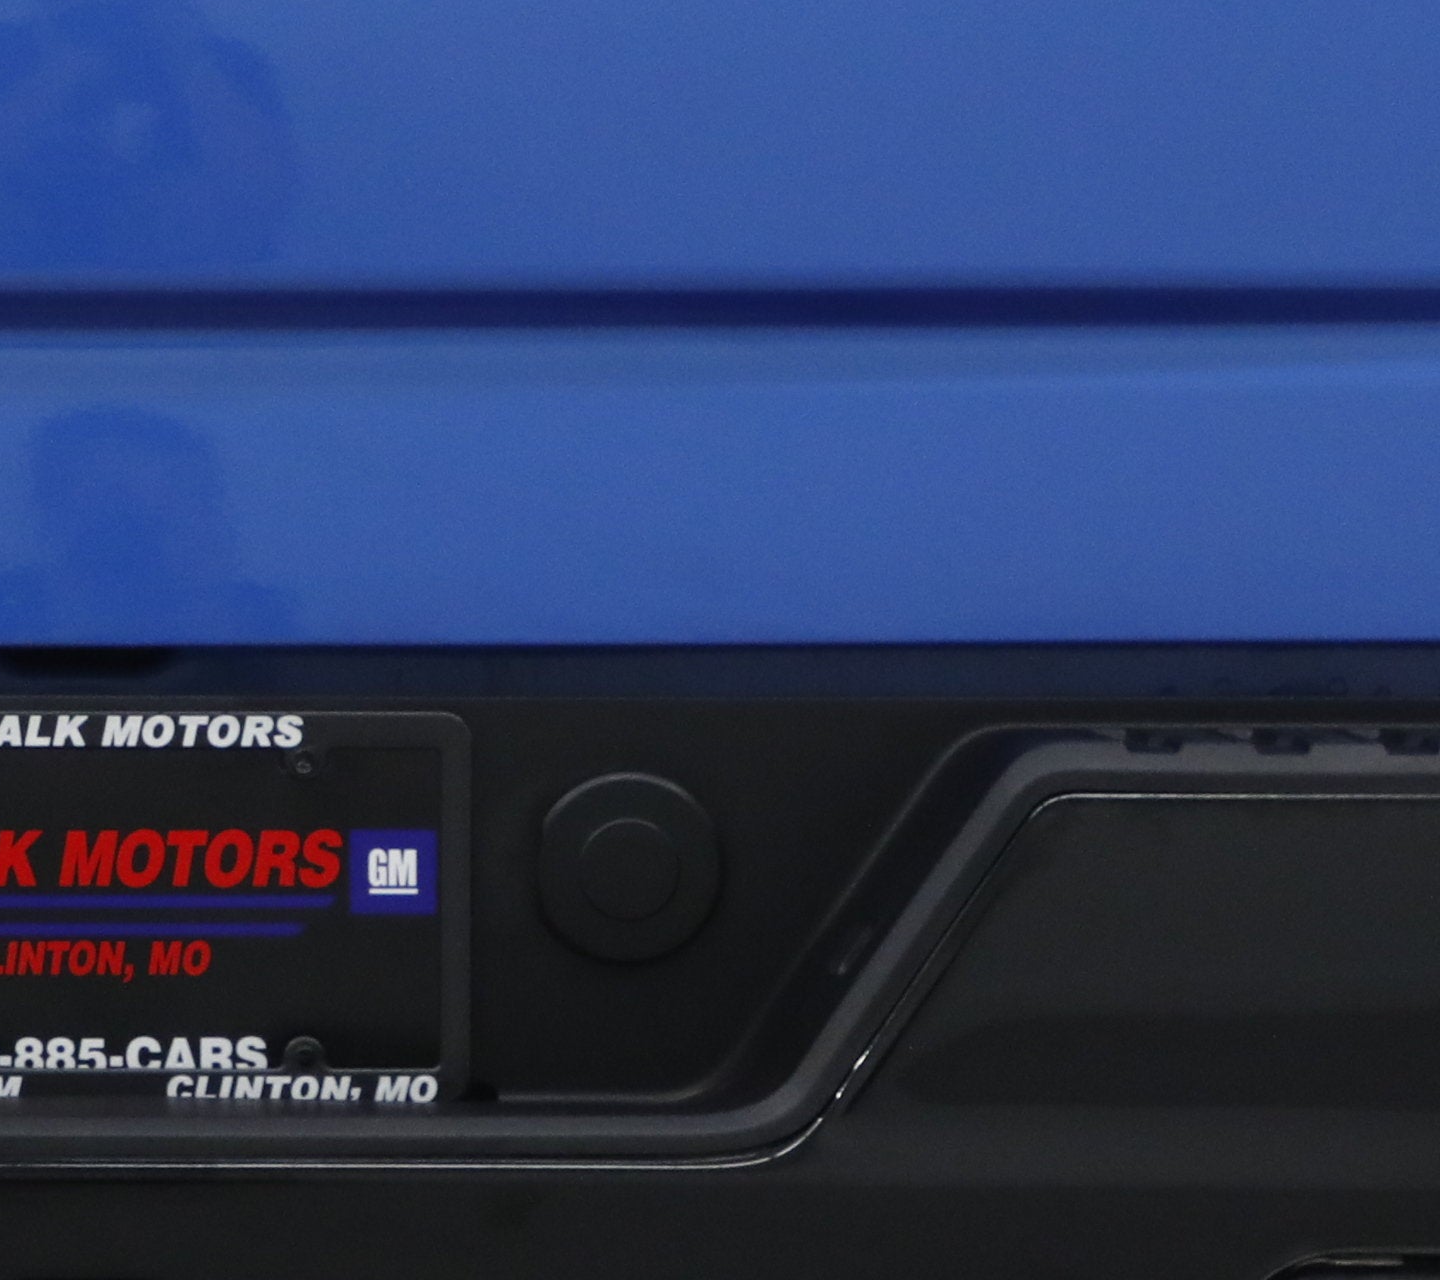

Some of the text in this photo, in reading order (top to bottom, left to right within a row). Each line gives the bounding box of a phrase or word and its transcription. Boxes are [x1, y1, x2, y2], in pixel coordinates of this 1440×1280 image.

[101, 714, 304, 748] MOTORS
[58, 828, 343, 888] MOTORS
[367, 846, 420, 888] GM
[148, 939, 212, 977] MO
[166, 1074, 439, 1104] CLINTON, MO
